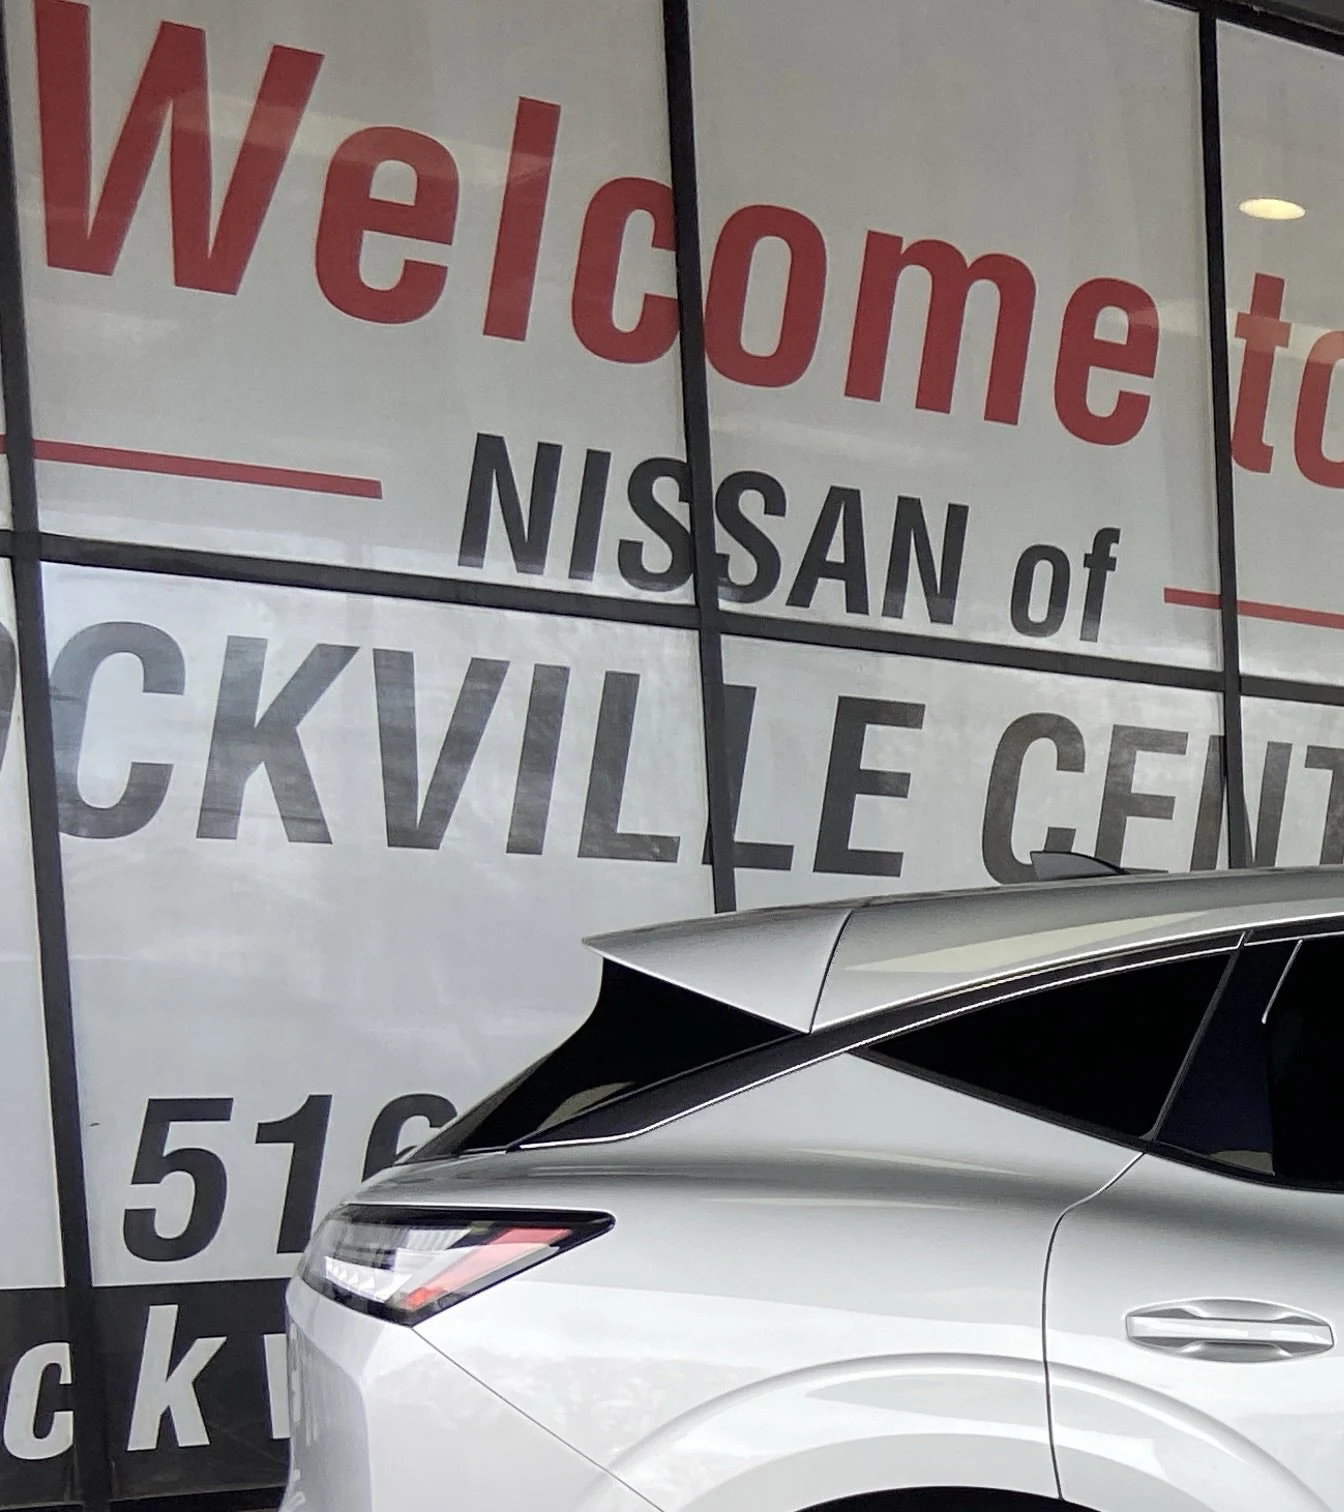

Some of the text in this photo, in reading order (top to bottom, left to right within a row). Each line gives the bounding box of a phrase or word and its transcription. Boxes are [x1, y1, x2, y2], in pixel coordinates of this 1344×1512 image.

[33, 0, 1160, 447] Welcome
[457, 433, 1121, 644] NISSAN of
[0, 620, 926, 878] CKVILLE
